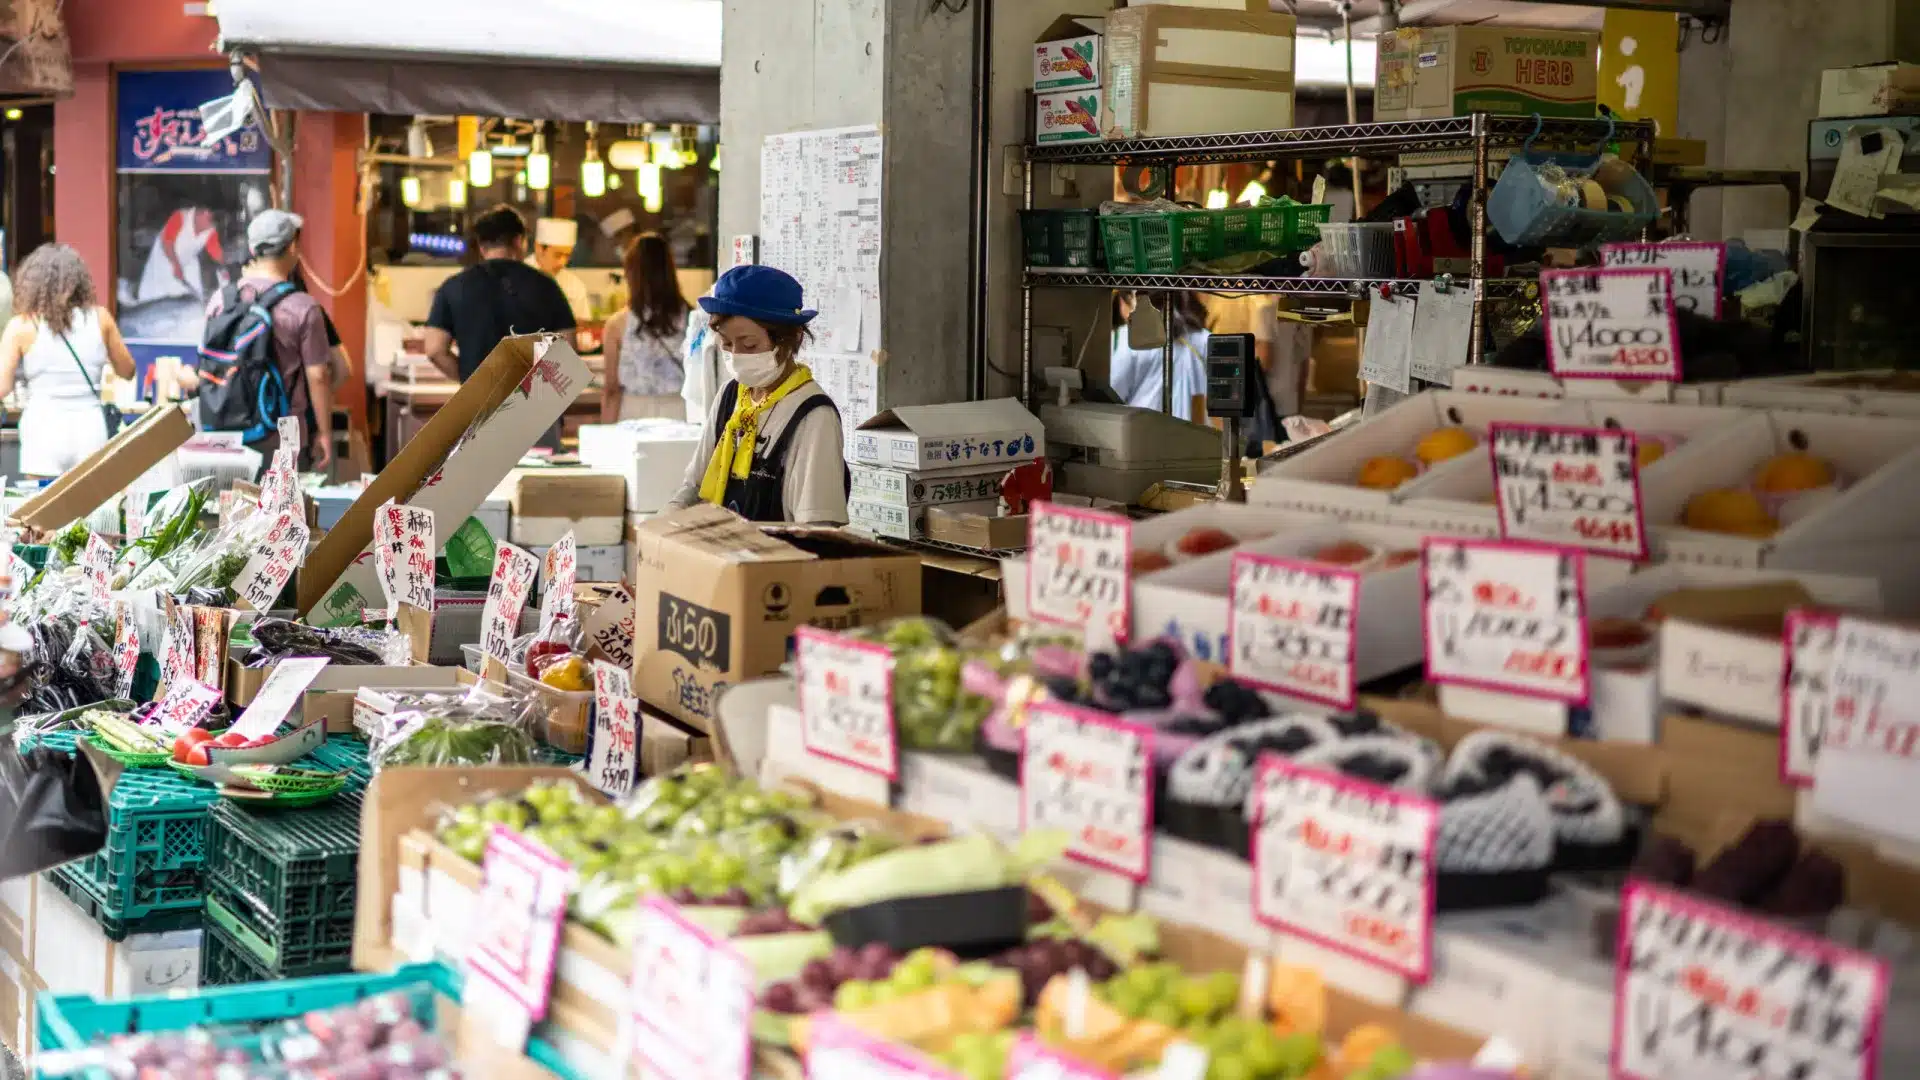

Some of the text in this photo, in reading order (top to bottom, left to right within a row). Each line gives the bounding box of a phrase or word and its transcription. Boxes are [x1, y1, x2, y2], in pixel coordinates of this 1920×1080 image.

[1515, 58, 1574, 86] HERB
[388, 507, 404, 539] 熊本
[407, 586, 432, 612] 450円
[666, 601, 718, 659] ふらの
